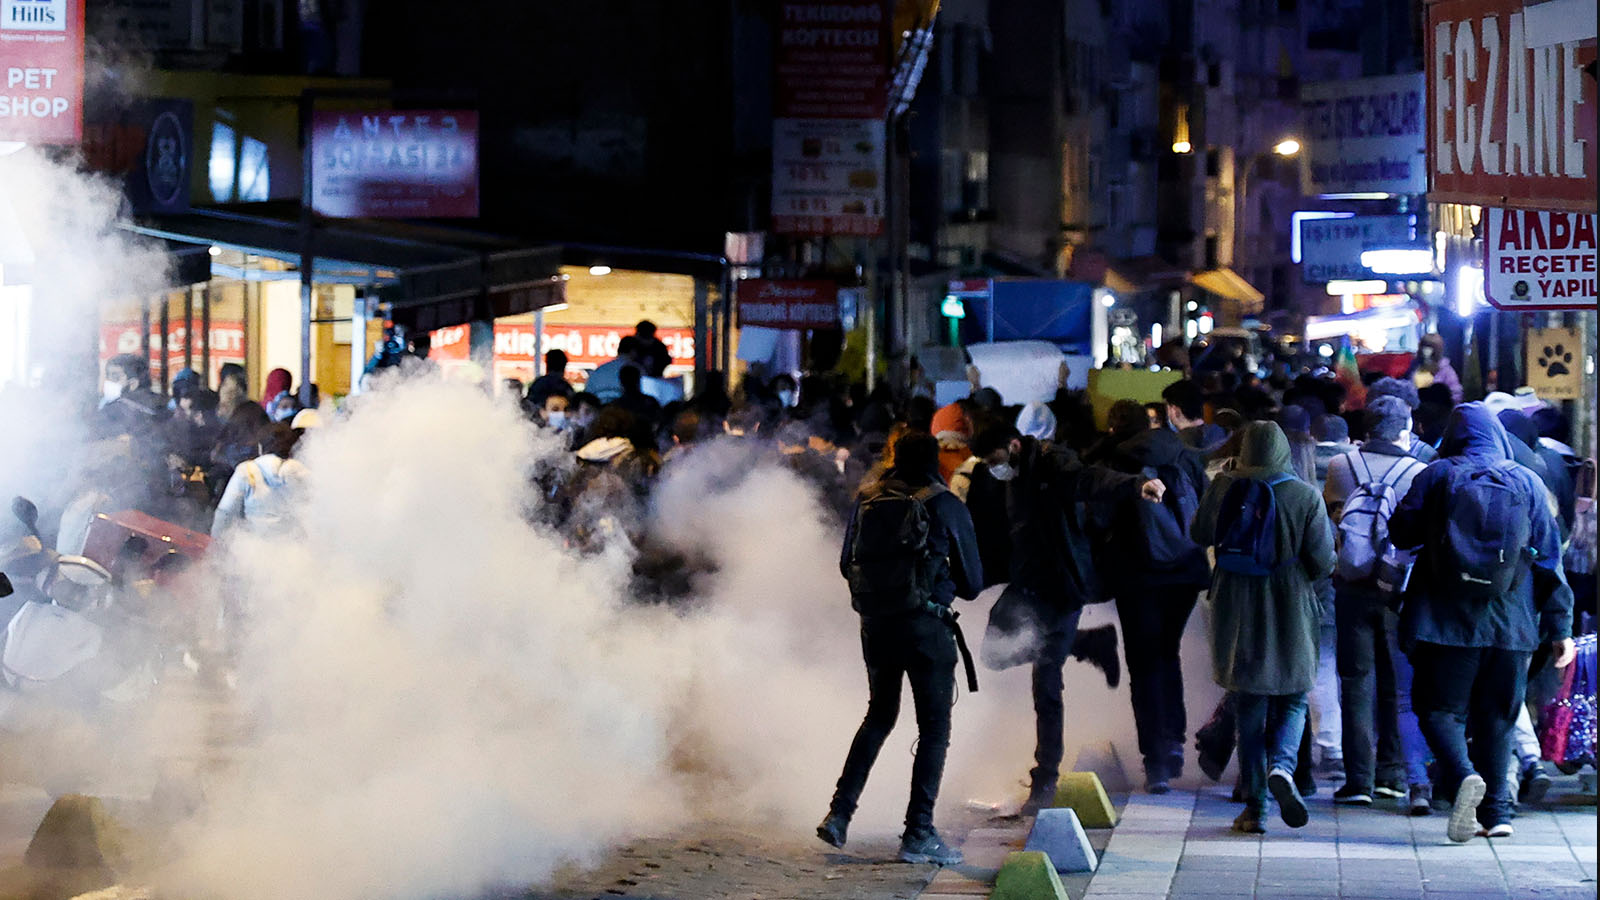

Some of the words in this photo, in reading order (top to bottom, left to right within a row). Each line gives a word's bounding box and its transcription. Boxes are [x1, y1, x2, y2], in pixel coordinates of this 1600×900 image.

[12, 5, 55, 23] Hill's
[8, 67, 58, 89] PET
[1435, 12, 1587, 178] ECZANE
[0, 95, 69, 118] SHOP
[1500, 255, 1596, 278] REÇETE
[1538, 279, 1597, 298] YAPIL
